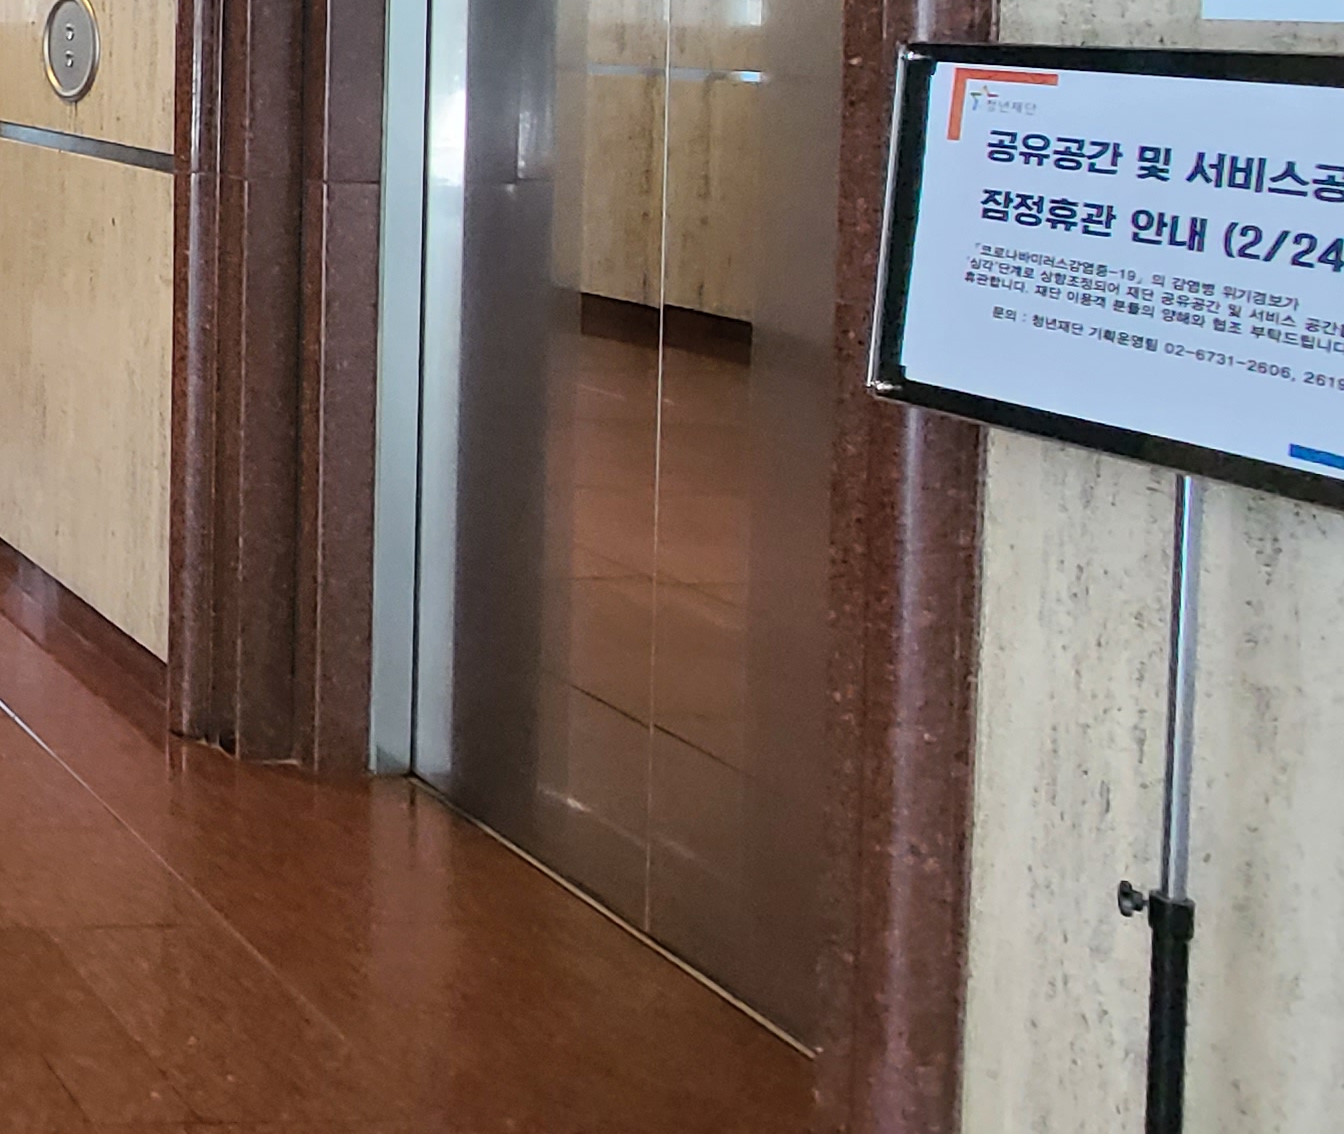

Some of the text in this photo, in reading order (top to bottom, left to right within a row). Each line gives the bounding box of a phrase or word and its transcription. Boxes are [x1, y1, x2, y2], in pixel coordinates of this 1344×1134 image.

[986, 129, 1344, 203] 공유공간 및 서비스공
[980, 188, 1344, 273] 잠정휴관 안내 (2/24
[1151, 273, 1166, 288] 의
[991, 305, 1018, 322] 문의
[1031, 313, 1084, 337] 청년재단
[1160, 291, 1222, 315] 공유공간
[1248, 307, 1298, 328] 서비스
[1304, 317, 1344, 338] 공간
